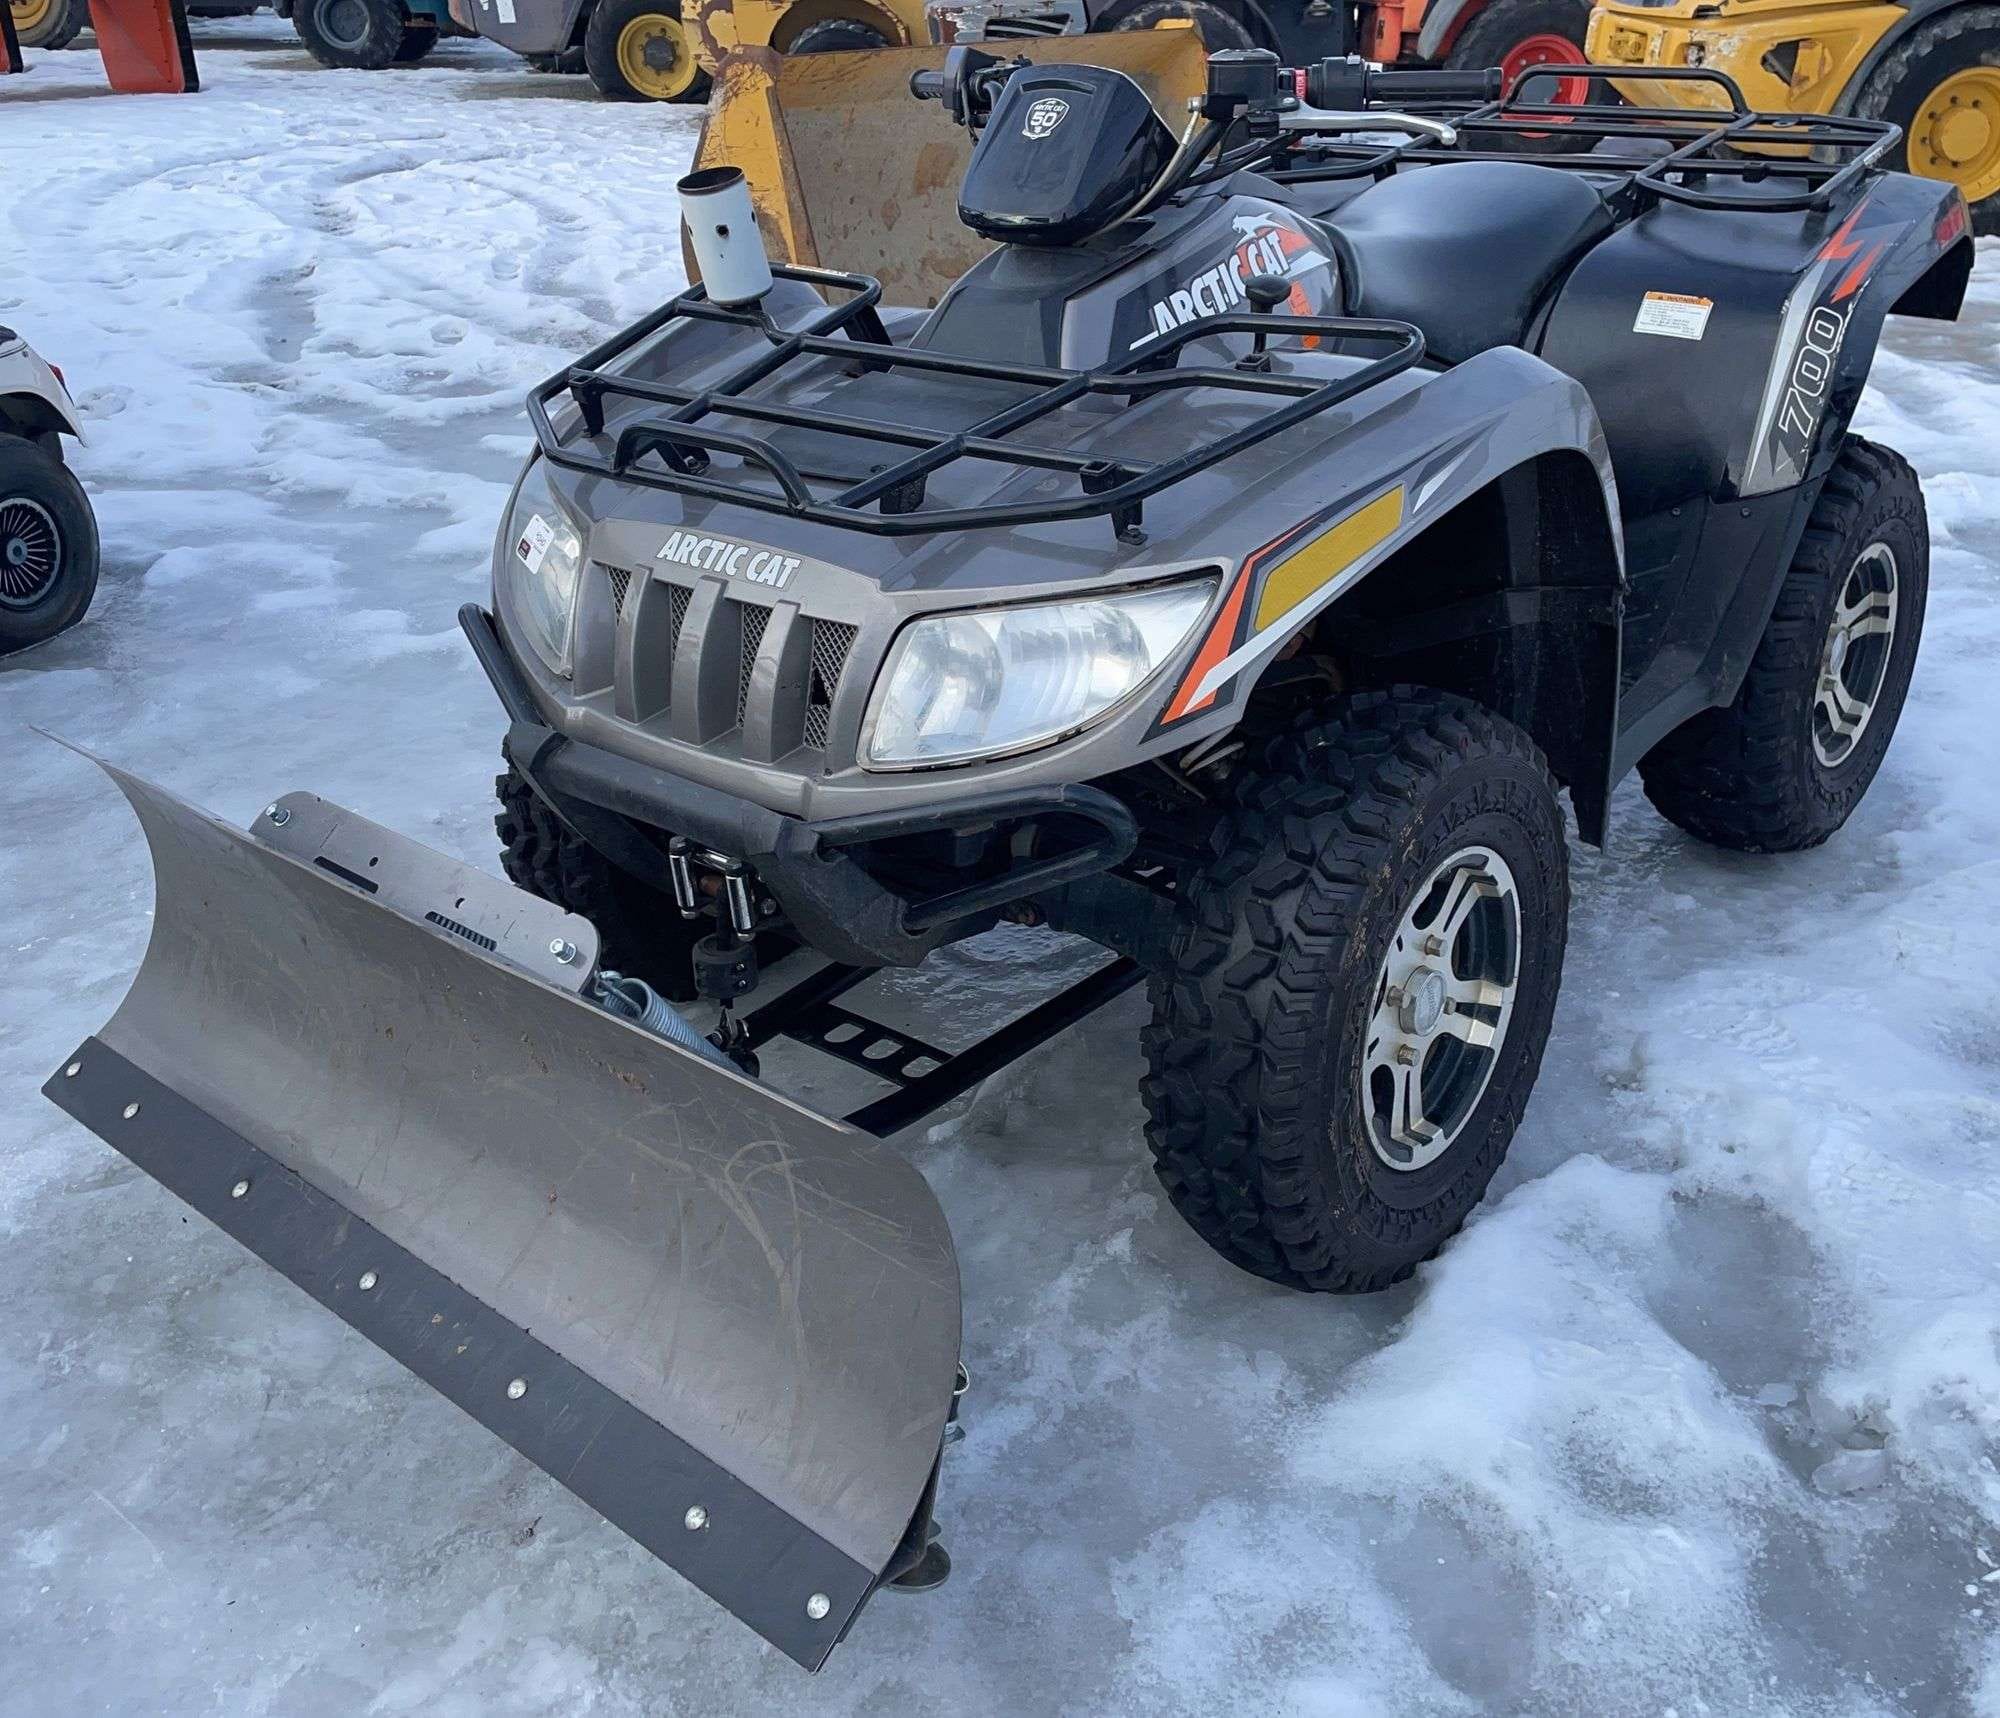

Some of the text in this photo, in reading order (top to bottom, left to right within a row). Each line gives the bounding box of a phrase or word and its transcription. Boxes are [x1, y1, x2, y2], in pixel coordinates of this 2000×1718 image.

[1030, 111, 1058, 126] 50
[1152, 231, 1290, 336] ARCTIC CAT
[1778, 305, 1843, 439] 700
[656, 532, 801, 589] ARCTIC CAT
